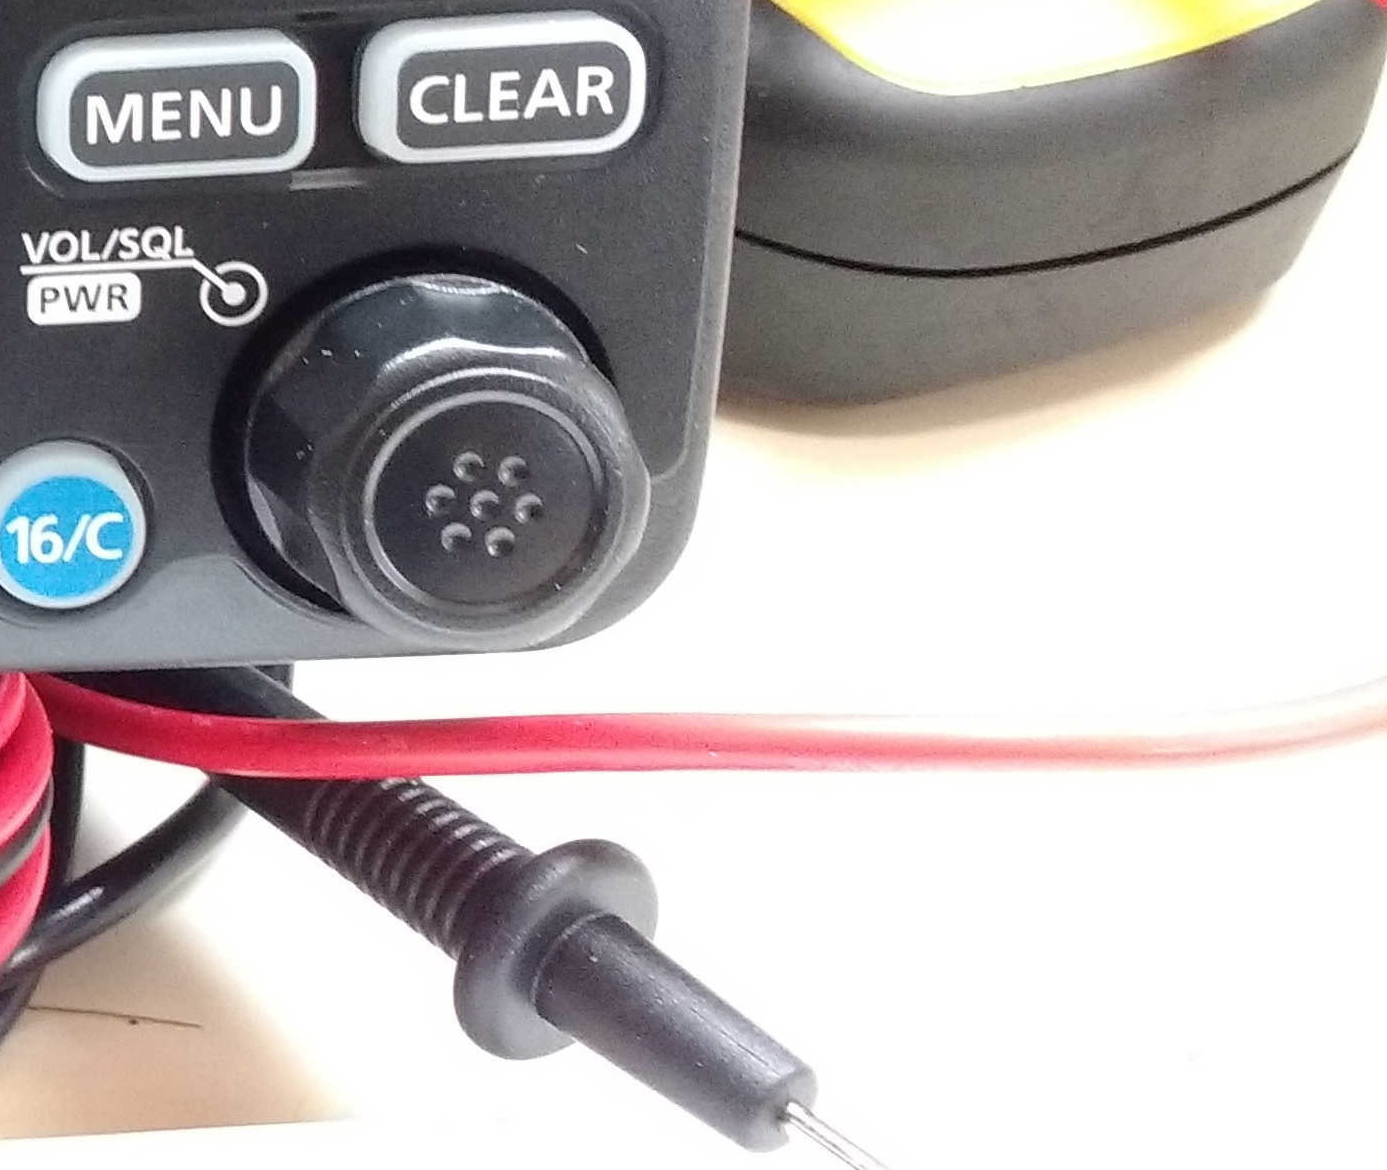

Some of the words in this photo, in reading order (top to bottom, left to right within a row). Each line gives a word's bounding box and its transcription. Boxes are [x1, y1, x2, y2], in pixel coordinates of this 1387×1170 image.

[85, 85, 284, 146] MENU
[410, 66, 615, 125] CLEAR
[22, 226, 194, 262] VOL/SQL
[39, 283, 129, 314] PWR
[6, 511, 126, 565] 16/C
